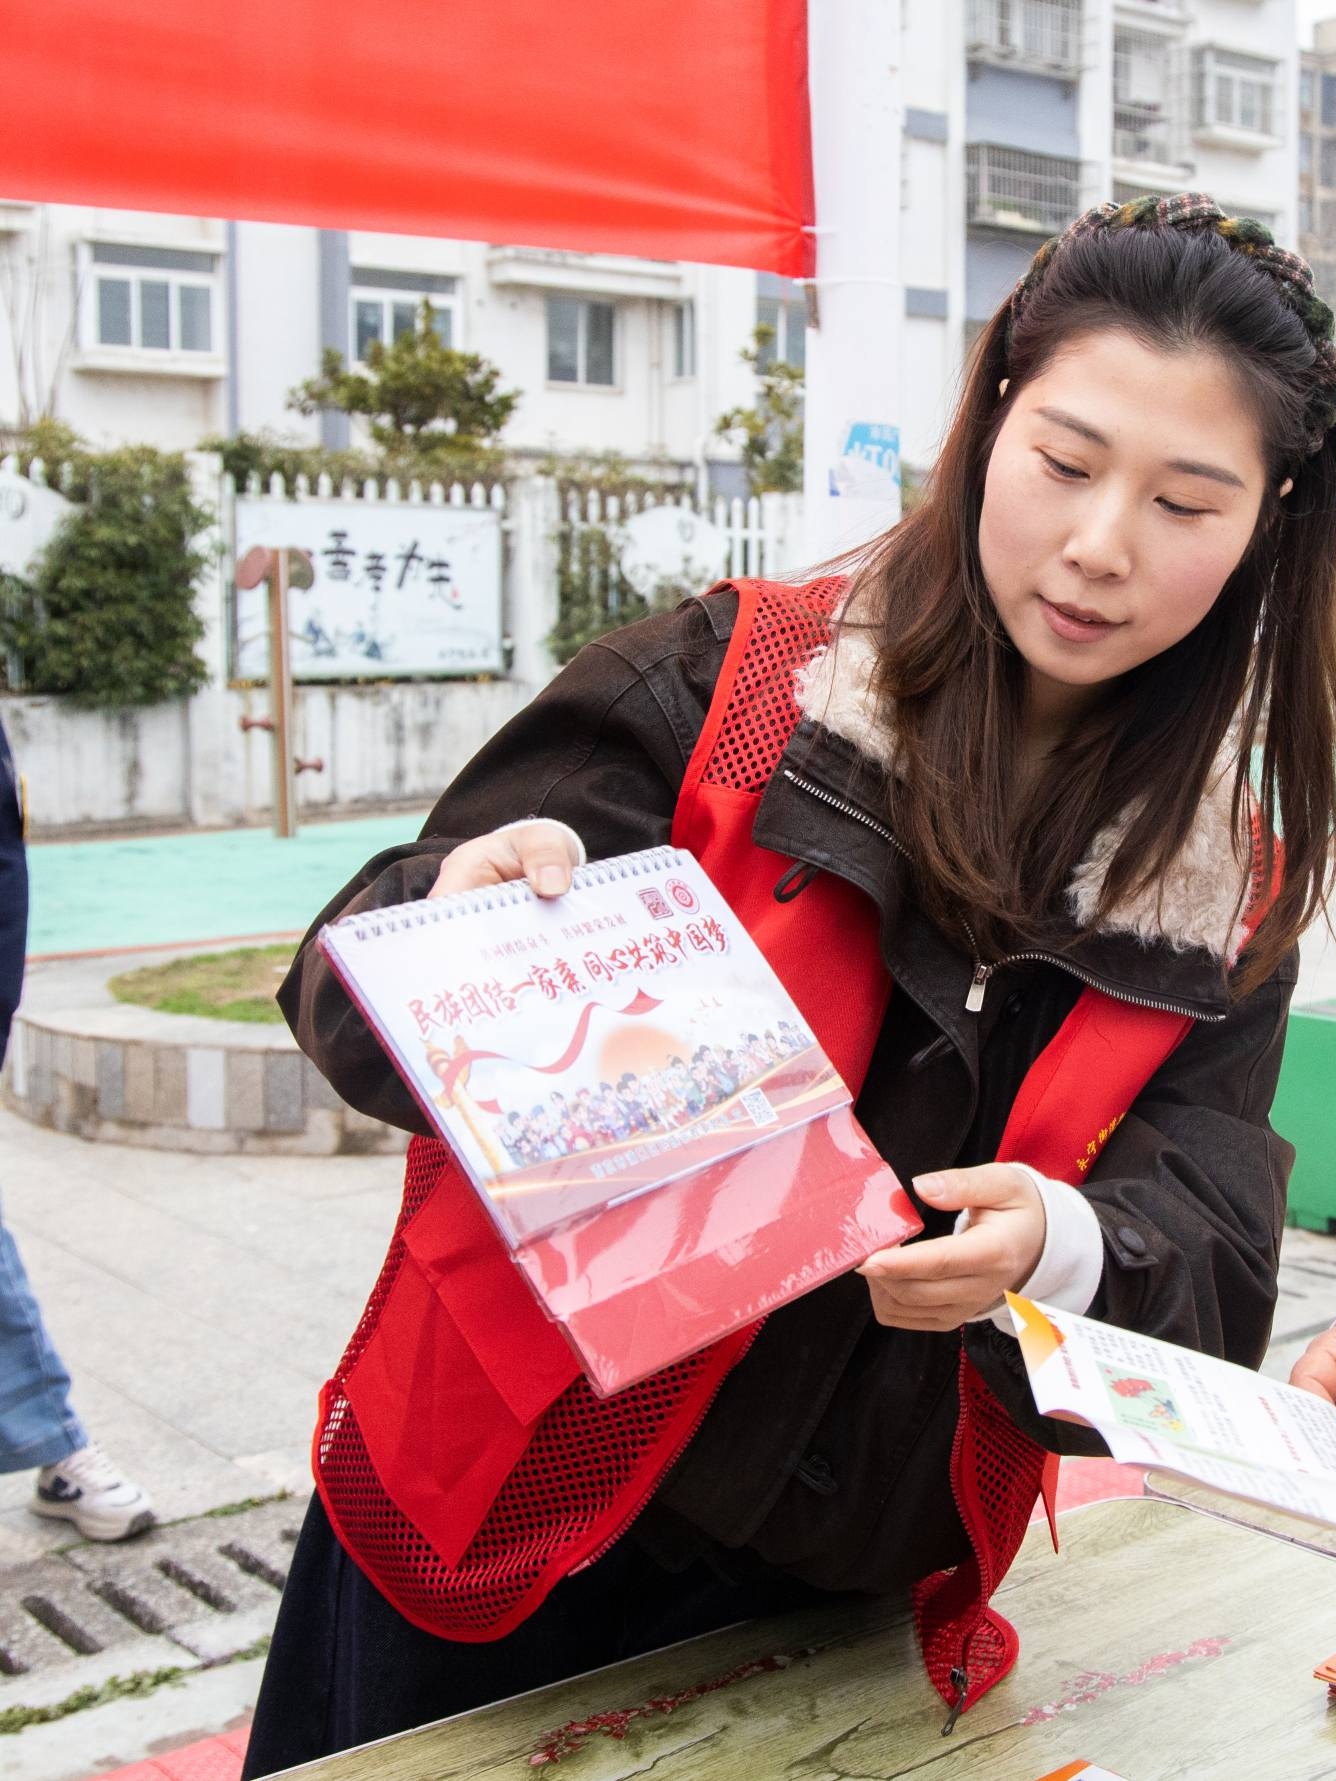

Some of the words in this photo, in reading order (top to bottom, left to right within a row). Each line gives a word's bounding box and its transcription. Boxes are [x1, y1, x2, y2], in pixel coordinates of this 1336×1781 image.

[407, 957, 586, 1036] 民族团结一家亲
[583, 914, 728, 982] 同心共筑中国梦
